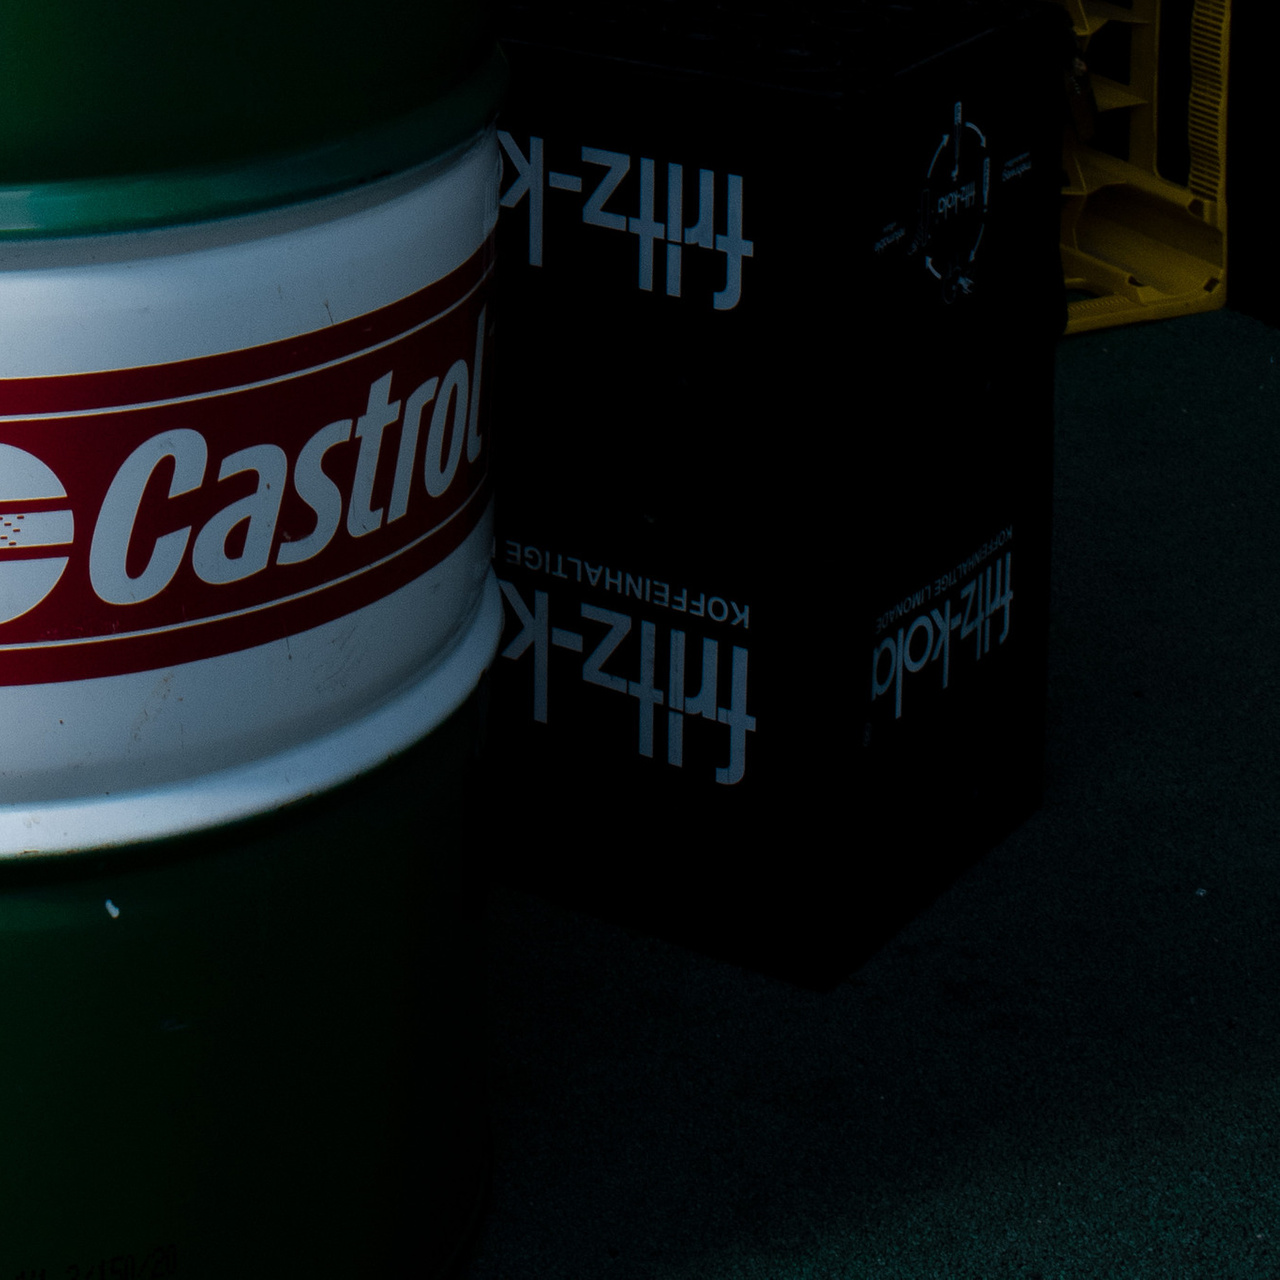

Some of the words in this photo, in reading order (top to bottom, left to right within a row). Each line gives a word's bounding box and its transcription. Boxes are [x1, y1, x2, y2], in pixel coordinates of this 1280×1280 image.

[87, 301, 487, 605] Castrol
[505, 539, 751, 630] KOFFEINHALTIGE
[871, 551, 1014, 720] fritz-kola
[874, 584, 932, 636] LIMONADE
